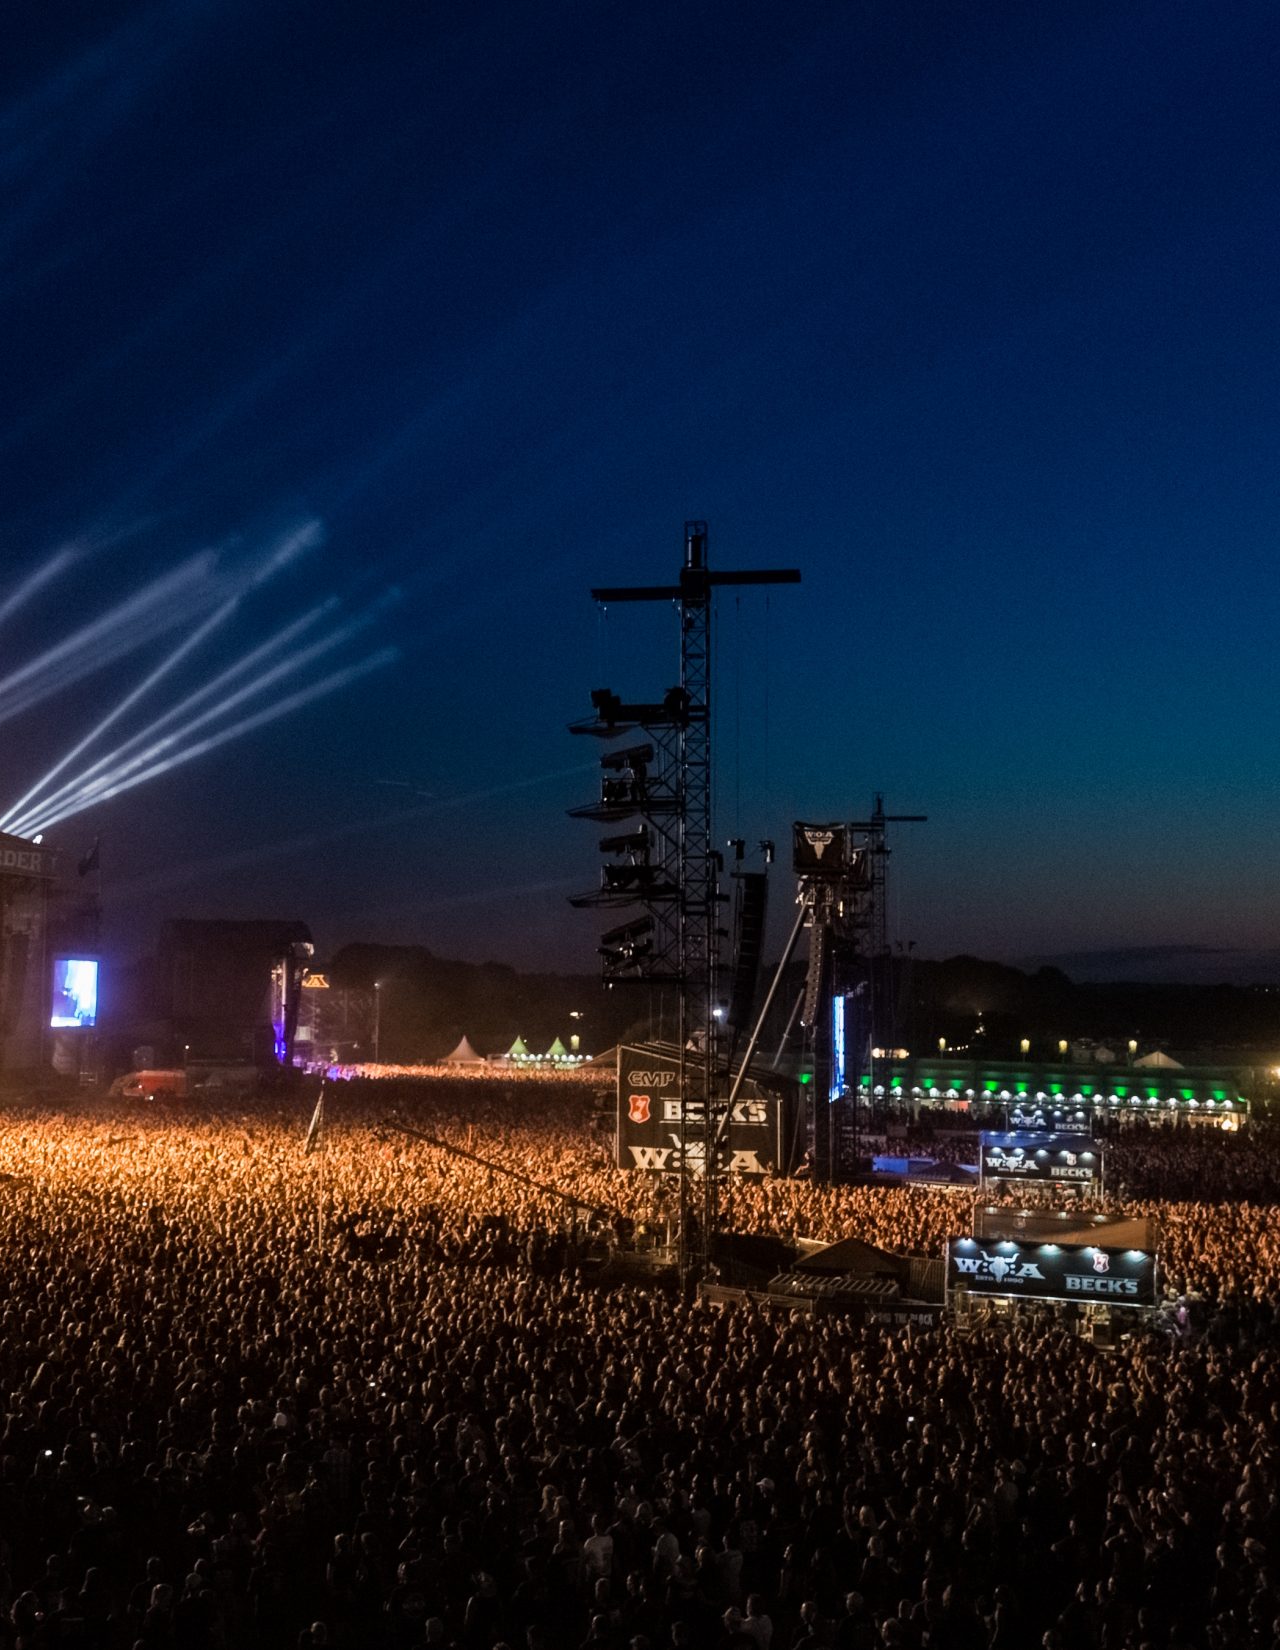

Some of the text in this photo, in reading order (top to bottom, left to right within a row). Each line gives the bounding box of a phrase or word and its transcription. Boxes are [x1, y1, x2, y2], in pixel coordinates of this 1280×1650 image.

[628, 1071, 676, 1087] EMP
[1050, 1167, 1093, 1178] BECK'S
[1066, 1277, 1138, 1294] BECK'S
